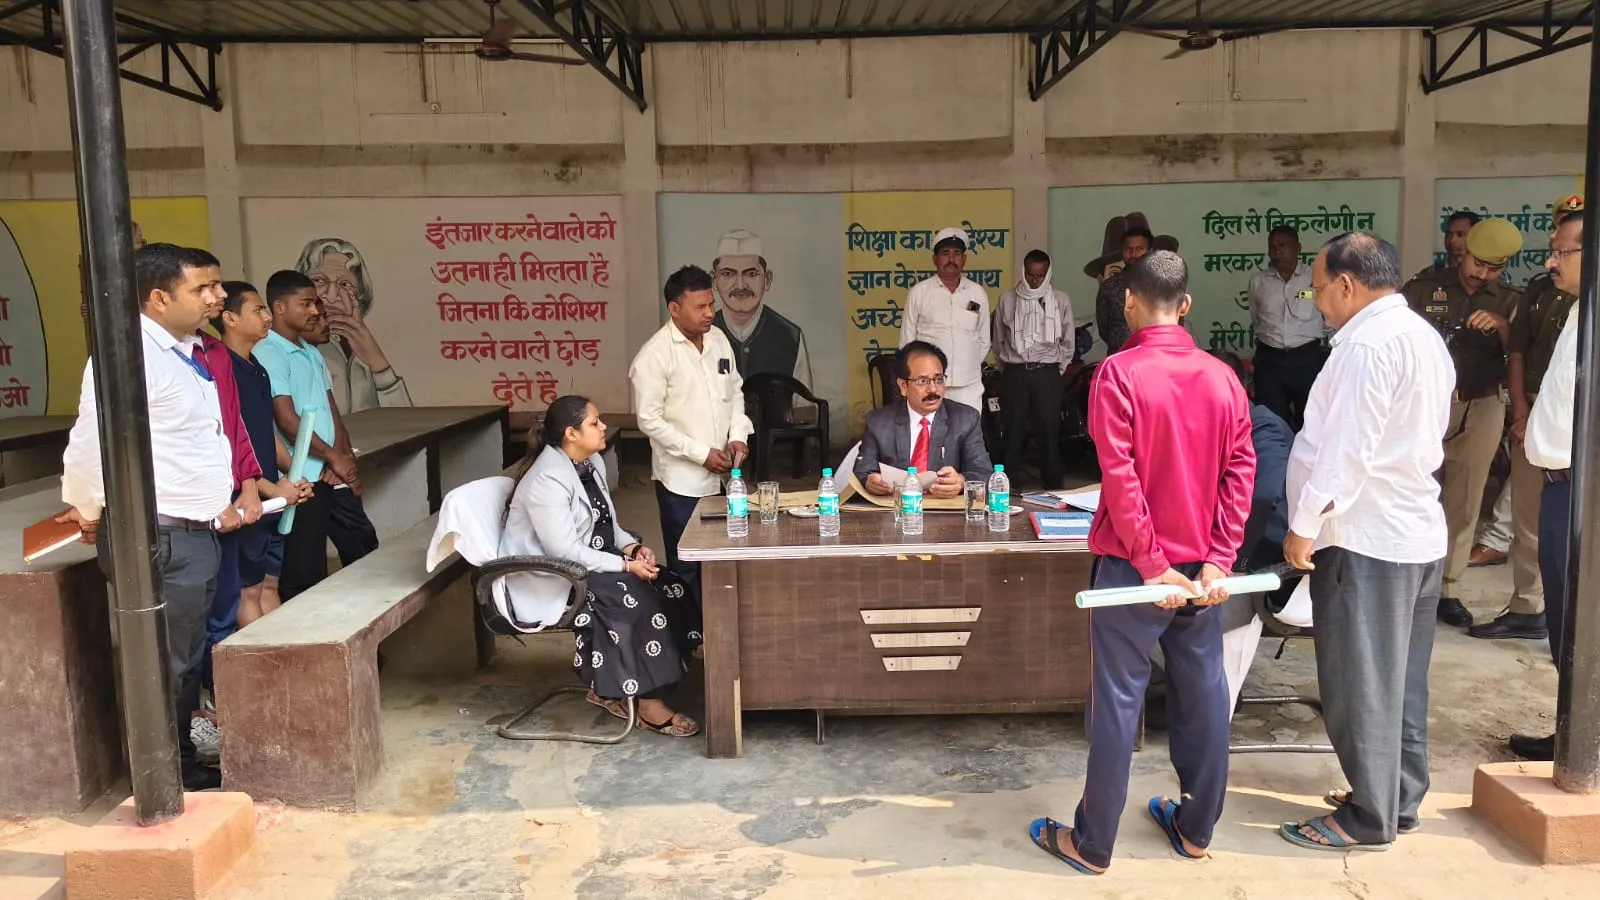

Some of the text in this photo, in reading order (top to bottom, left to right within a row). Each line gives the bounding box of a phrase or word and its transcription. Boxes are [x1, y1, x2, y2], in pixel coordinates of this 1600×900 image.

[426, 211, 617, 250] इंतजार करने वाले को
[845, 222, 897, 258] शिक्षा
[899, 230, 932, 251] का
[1202, 210, 1243, 240] दिल
[1245, 208, 1262, 236] से
[1357, 212, 1376, 231] न
[431, 261, 491, 286] उतना
[492, 252, 517, 290] ही
[519, 251, 588, 285] मिलता
[848, 270, 892, 296] ज्ञान
[894, 262, 916, 289] के
[1204, 253, 1265, 274] मरकर
[437, 292, 608, 324] जितना कि कोशिश
[440, 330, 601, 367] करने वाले छोड़
[1208, 320, 1247, 351] मेरी
[491, 371, 533, 408] देते
